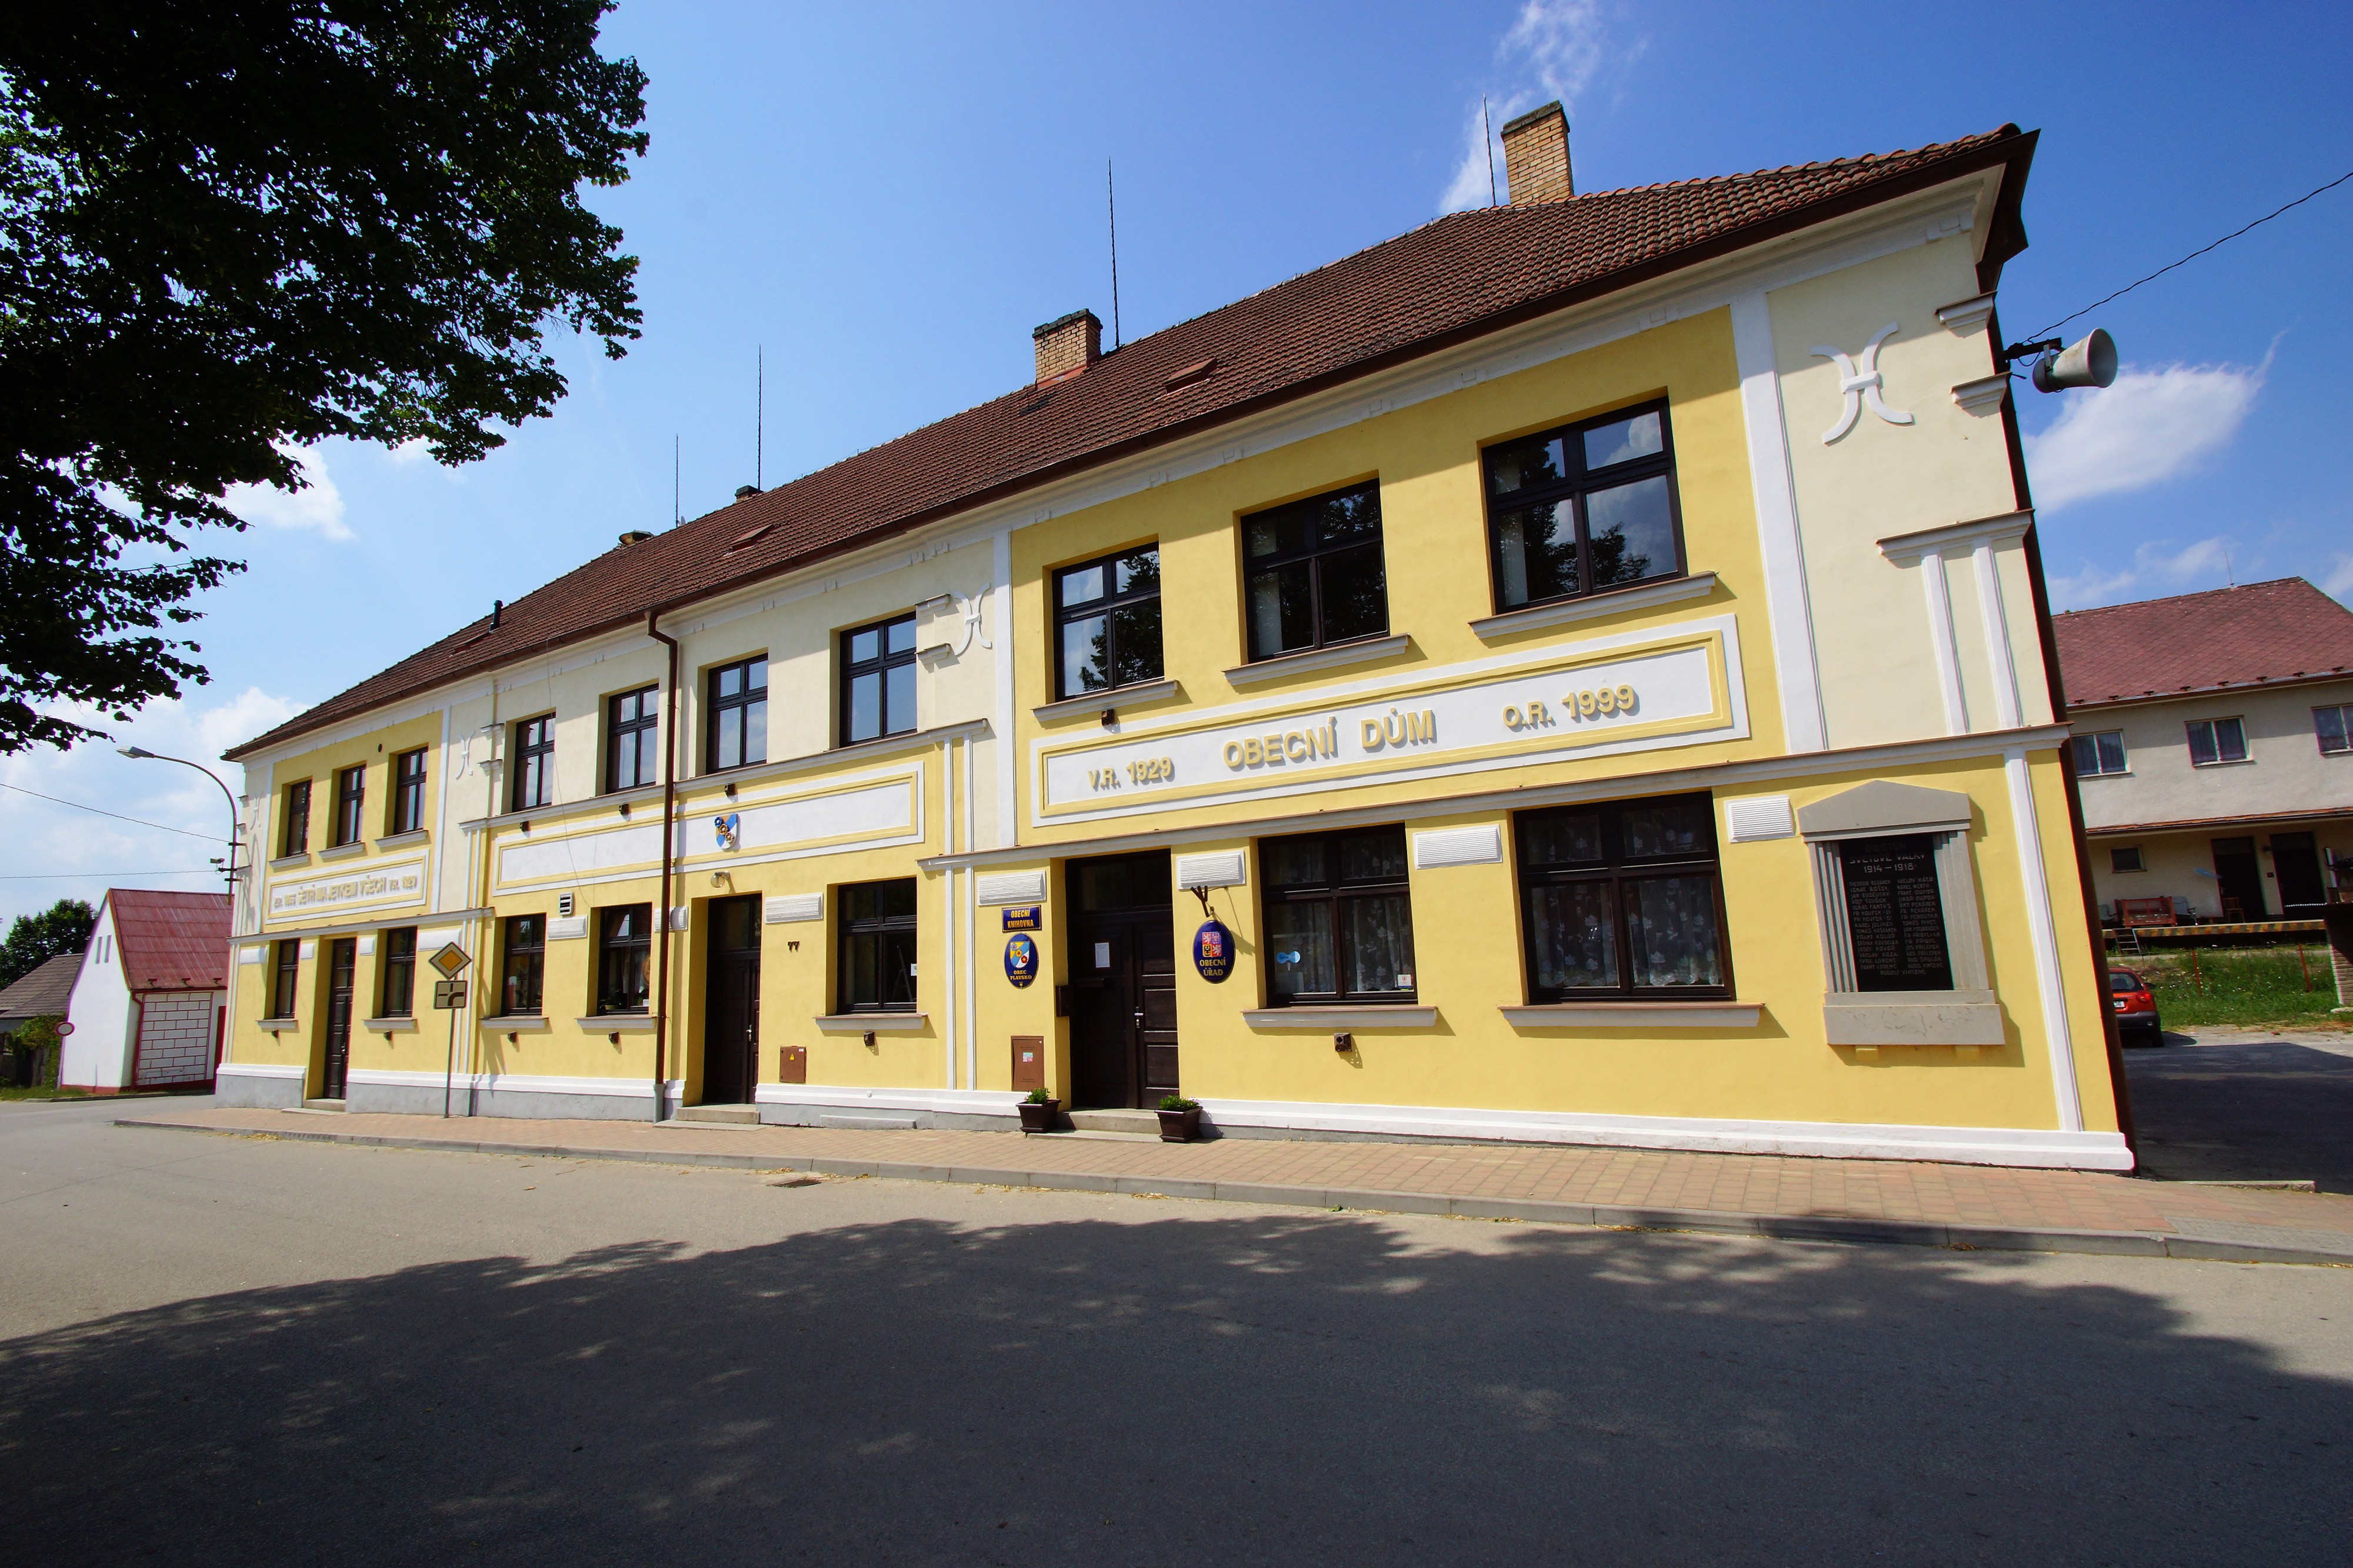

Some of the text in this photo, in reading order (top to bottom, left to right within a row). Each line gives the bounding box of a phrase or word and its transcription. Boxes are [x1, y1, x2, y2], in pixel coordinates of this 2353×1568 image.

[1088, 684, 1634, 789] V.R. 1929 OBECNÍ DŮM O.R. 1999
[360, 875, 386, 896] VŠECH
[1011, 908, 1031, 918] OBECNÍ
[1007, 919, 1034, 928] KNIHOVNA
[1199, 957, 1227, 966] OBECNÍ
[1203, 968, 1224, 976] ÚŘAD
